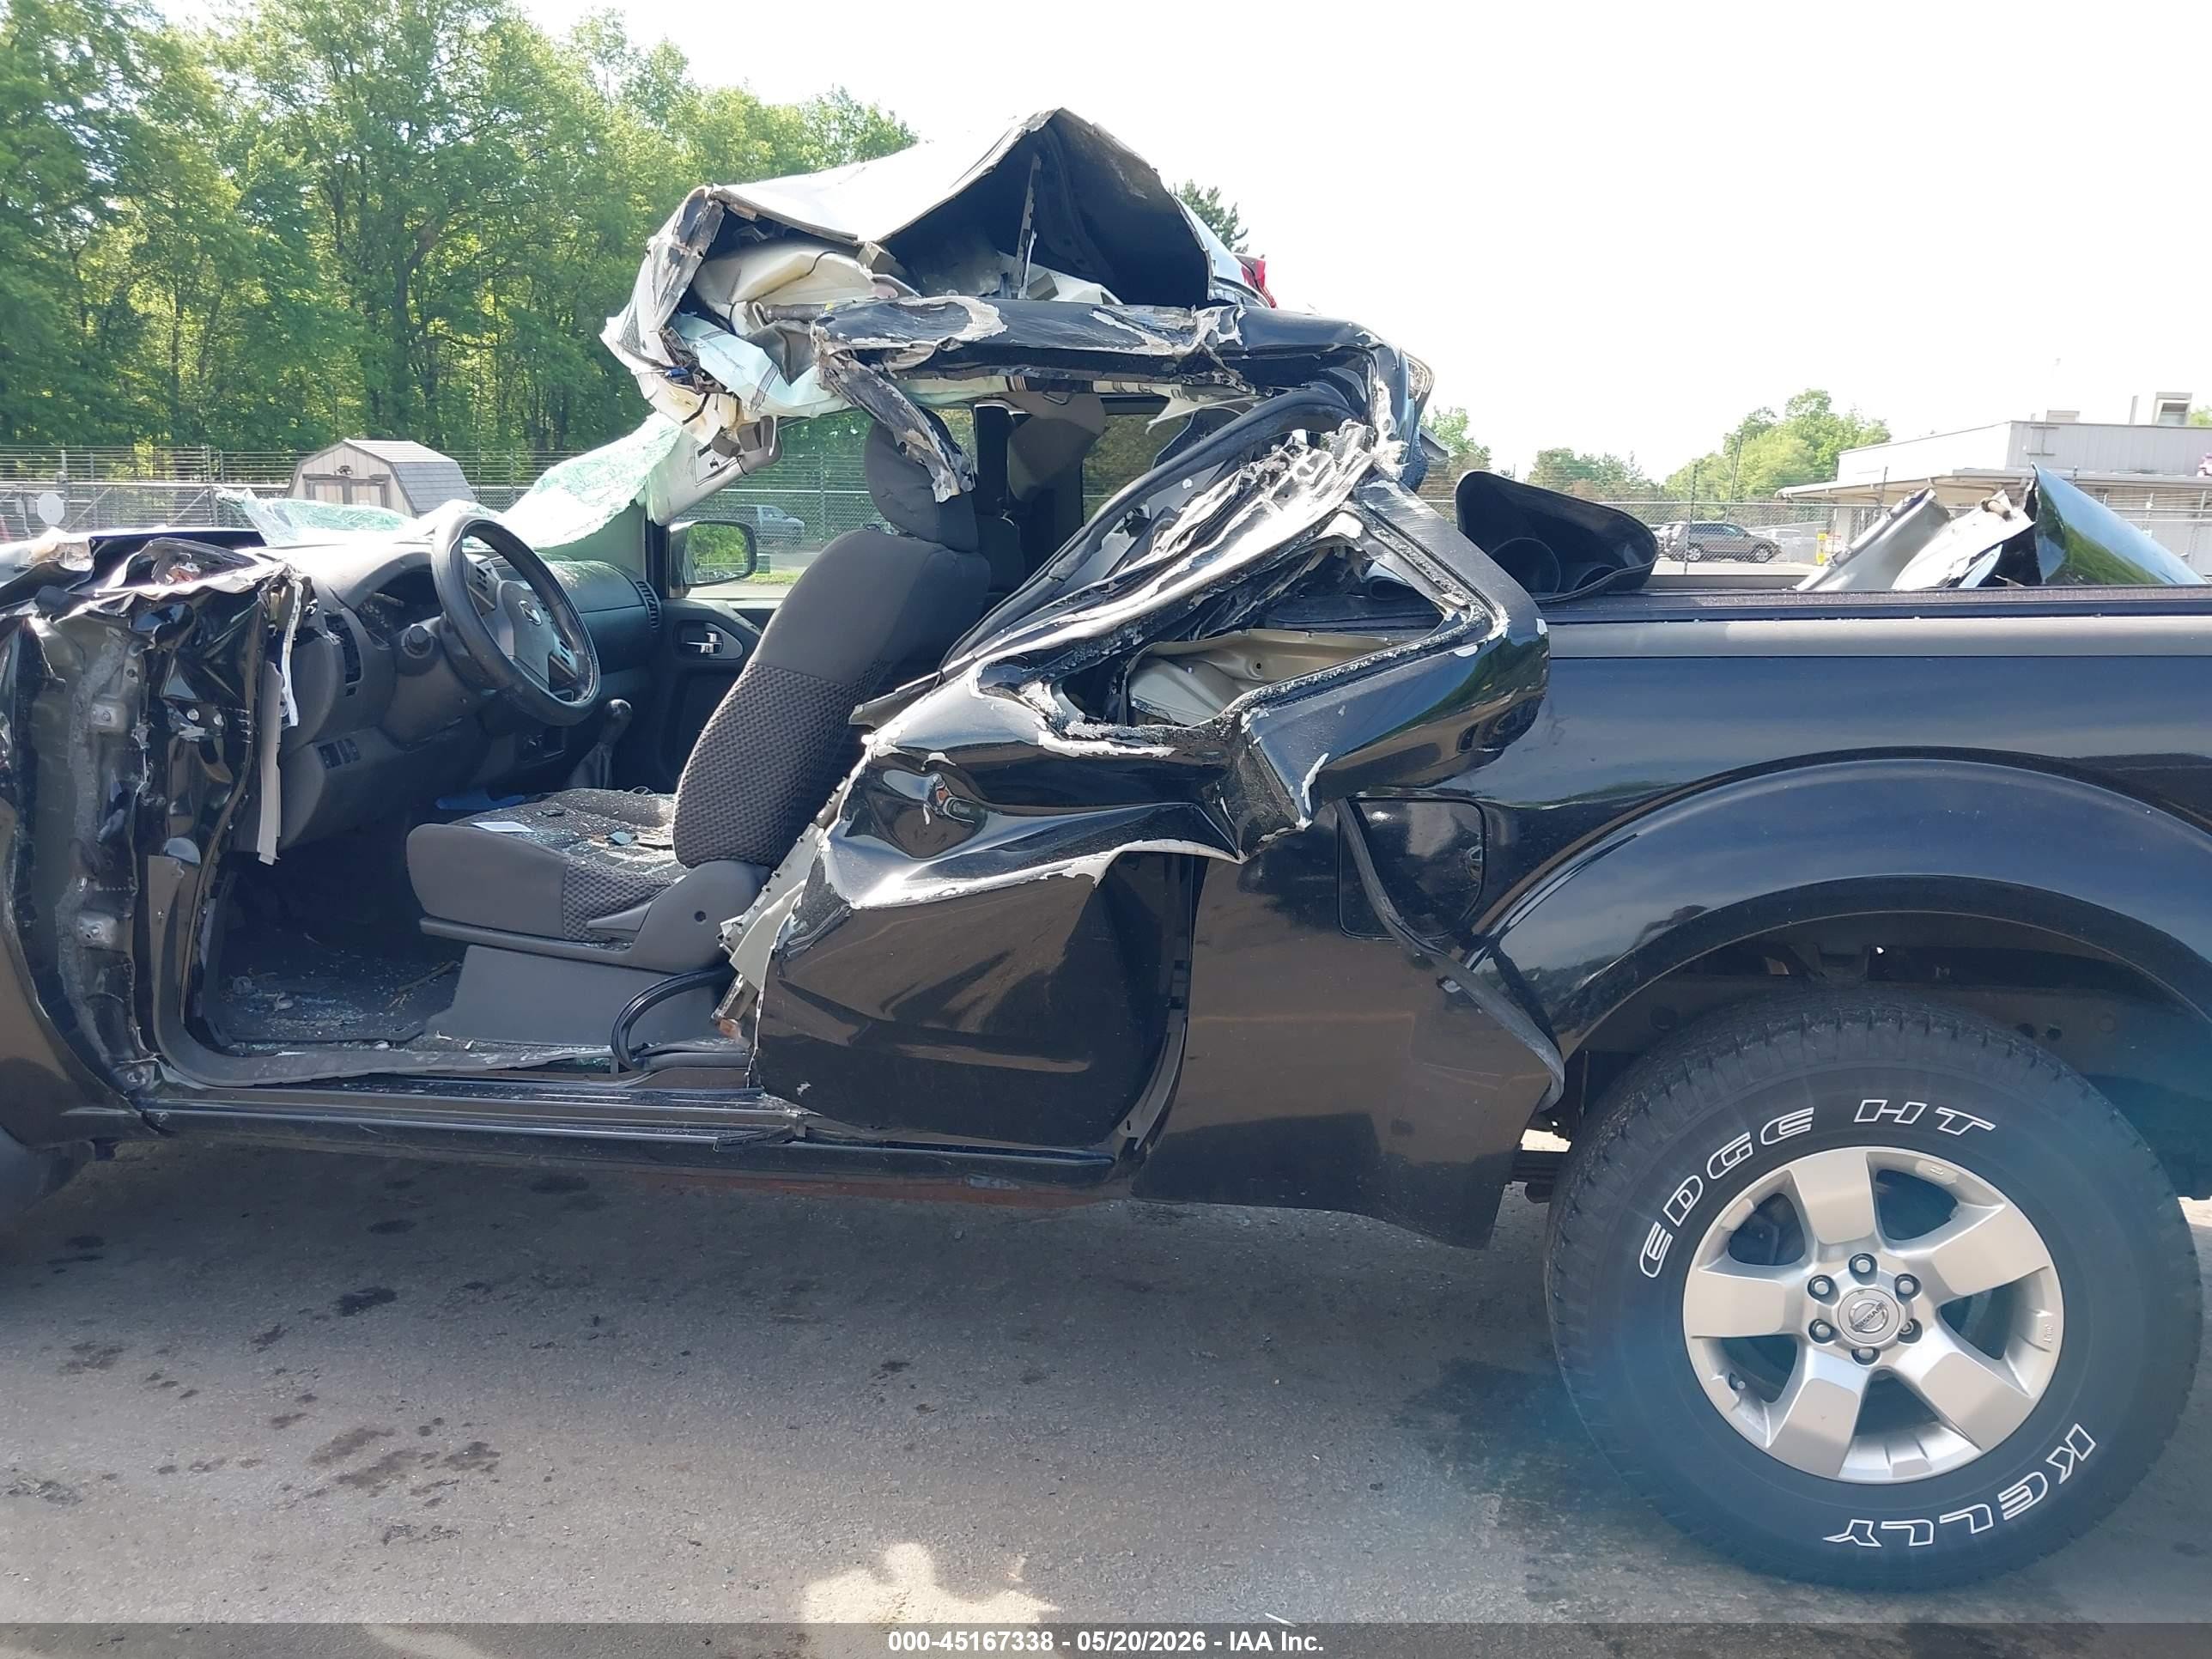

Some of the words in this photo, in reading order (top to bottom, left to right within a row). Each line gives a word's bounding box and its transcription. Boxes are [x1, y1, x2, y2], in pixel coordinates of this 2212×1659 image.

[1638, 1106, 1815, 1279] EDGE
[1853, 1098, 1996, 1137] HT
[1853, 1301, 1883, 1330] NISSAN
[1822, 1422, 2097, 1548] KELLY
